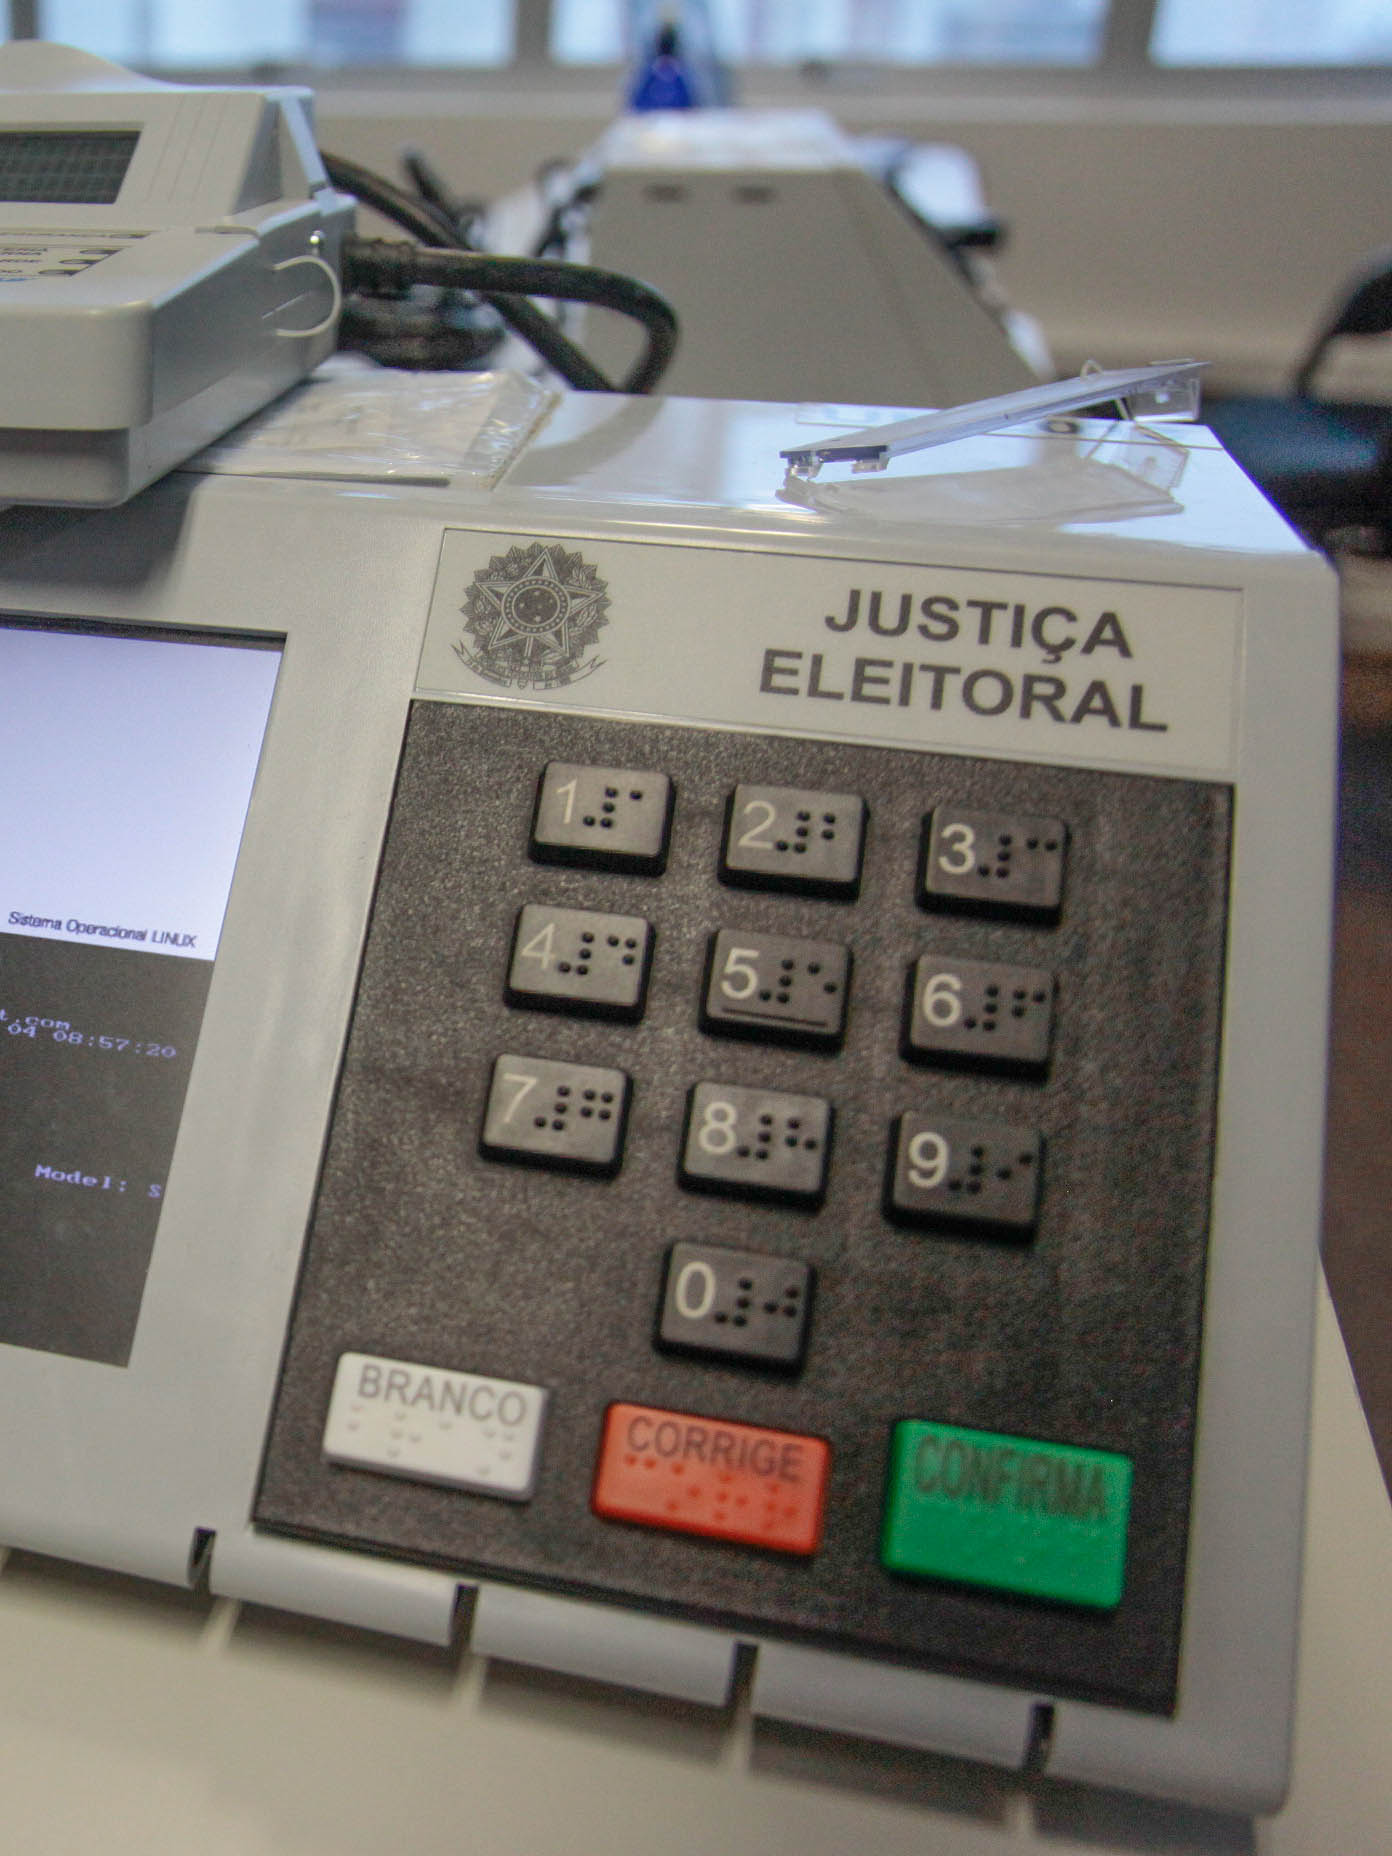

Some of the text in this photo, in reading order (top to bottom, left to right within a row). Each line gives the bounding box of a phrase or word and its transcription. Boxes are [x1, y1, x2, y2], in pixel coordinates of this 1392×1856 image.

[824, 589, 1133, 664] JUSTIÇA
[759, 648, 1168, 732] ELEITORAL
[555, 778, 578, 824] 1
[737, 801, 777, 851] 2
[938, 823, 977, 874] 3
[8, 911, 197, 948] Sistema Operacional LINUX
[521, 922, 557, 970] 4
[719, 947, 760, 999] 5
[922, 973, 962, 1027] 6
[5, 1023, 38, 1037] 04
[50, 1030, 175, 1058] 08:57:20
[503, 1073, 537, 1124] 7
[698, 1101, 738, 1154] 8
[34, 1164, 128, 1192] Model:
[148, 1184, 161, 1198] S
[909, 1132, 950, 1188] 9
[675, 1260, 717, 1318] 0
[356, 1363, 528, 1428] BRANCO
[626, 1415, 805, 1484] CORRIGE
[913, 1434, 1109, 1519] CONFIRMA
